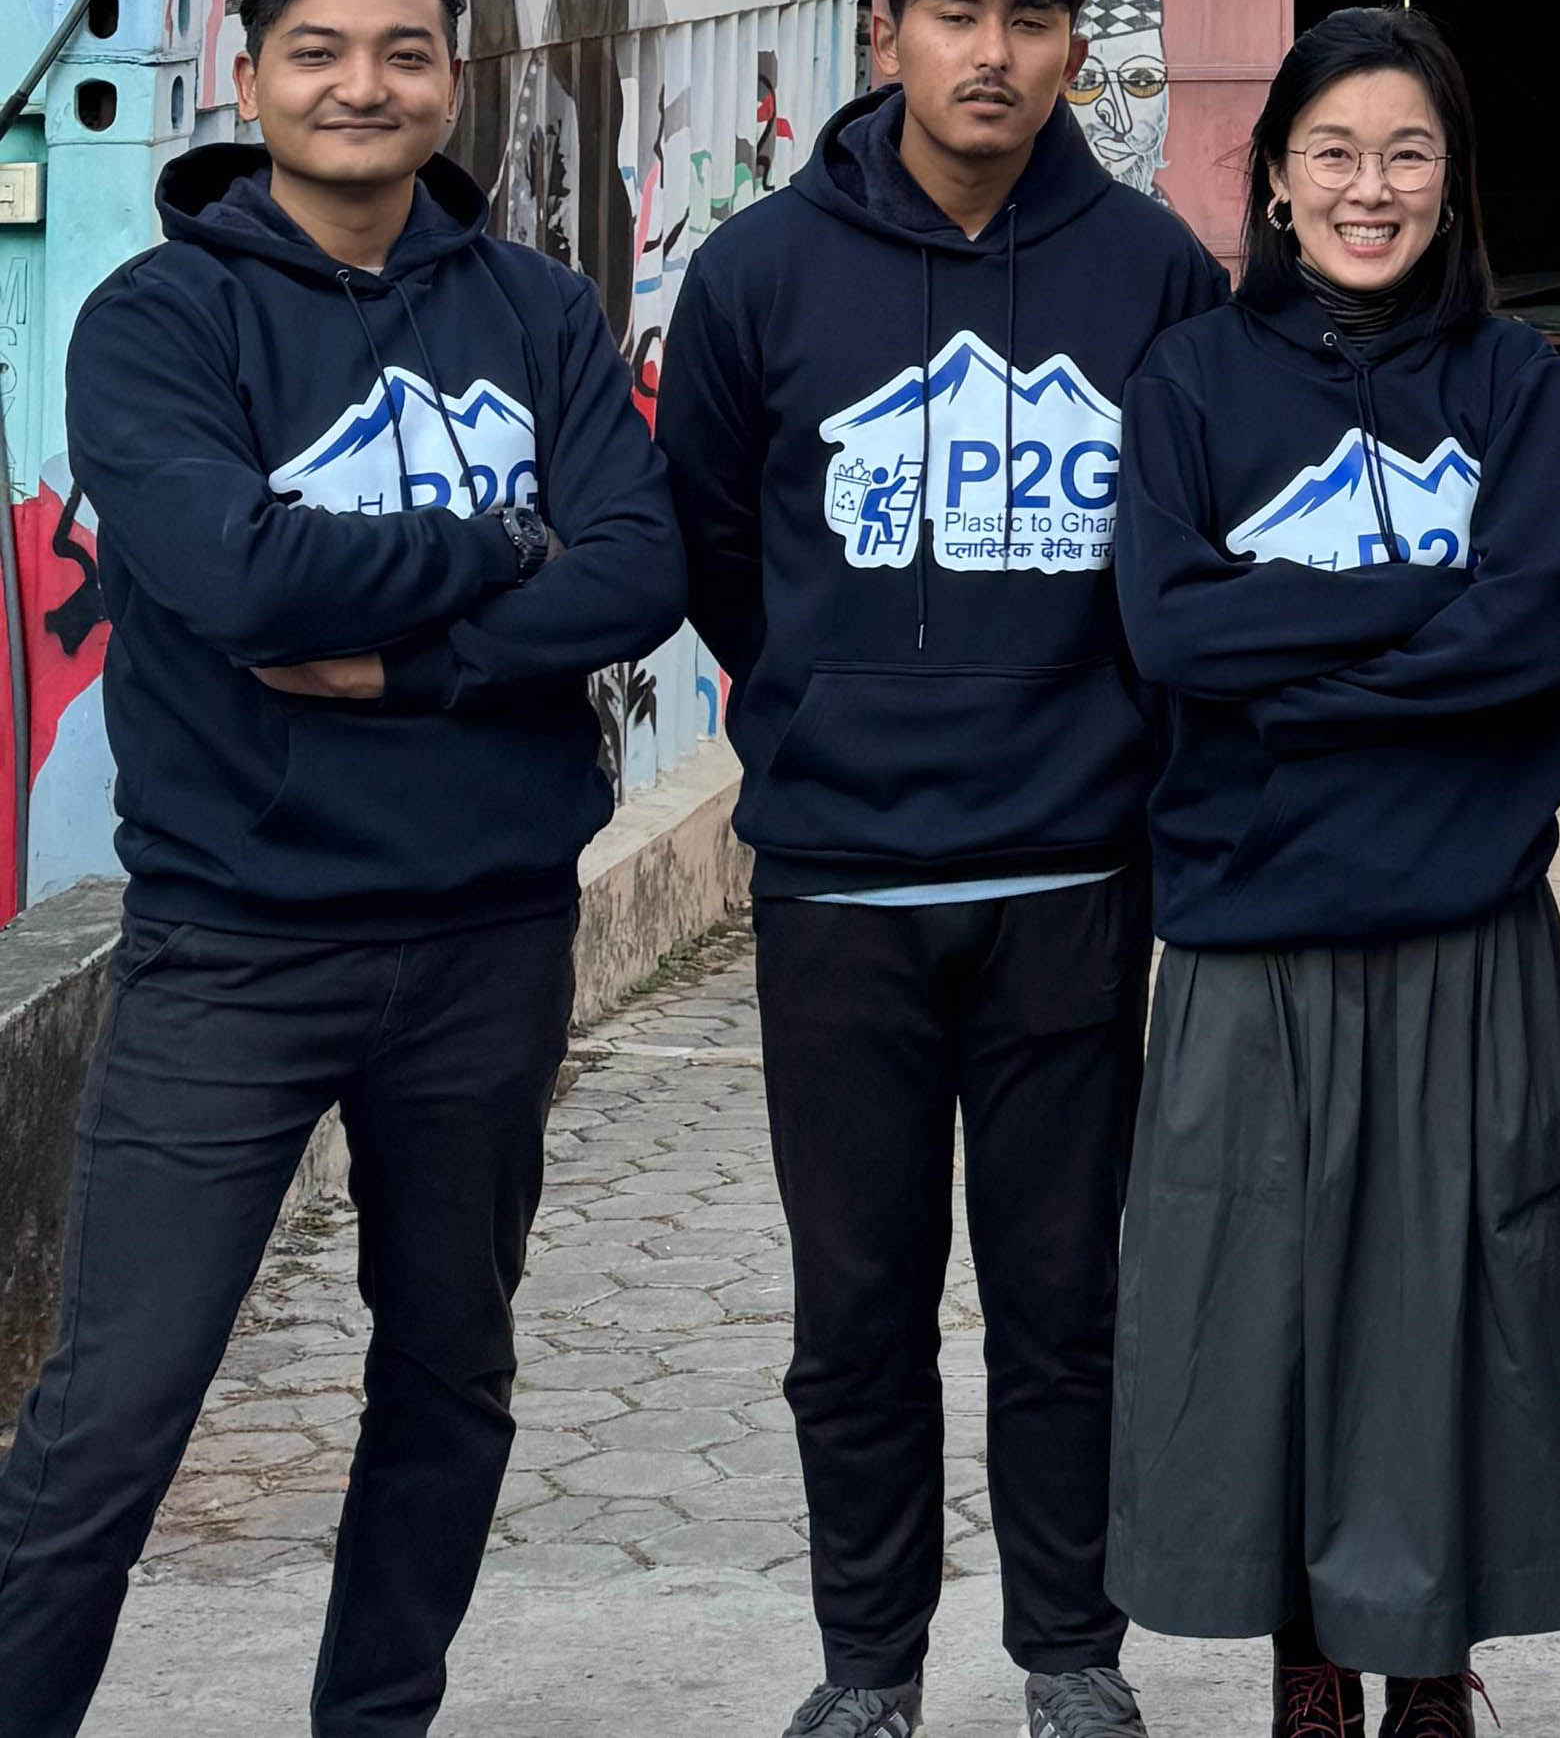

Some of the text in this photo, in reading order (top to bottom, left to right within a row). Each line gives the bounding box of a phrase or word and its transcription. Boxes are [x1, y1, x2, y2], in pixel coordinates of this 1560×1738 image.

[946, 440, 1120, 510] P2G
[944, 511, 1023, 533] Plastc
[1031, 512, 1052, 533] to
[1041, 537, 1084, 561] देखि
